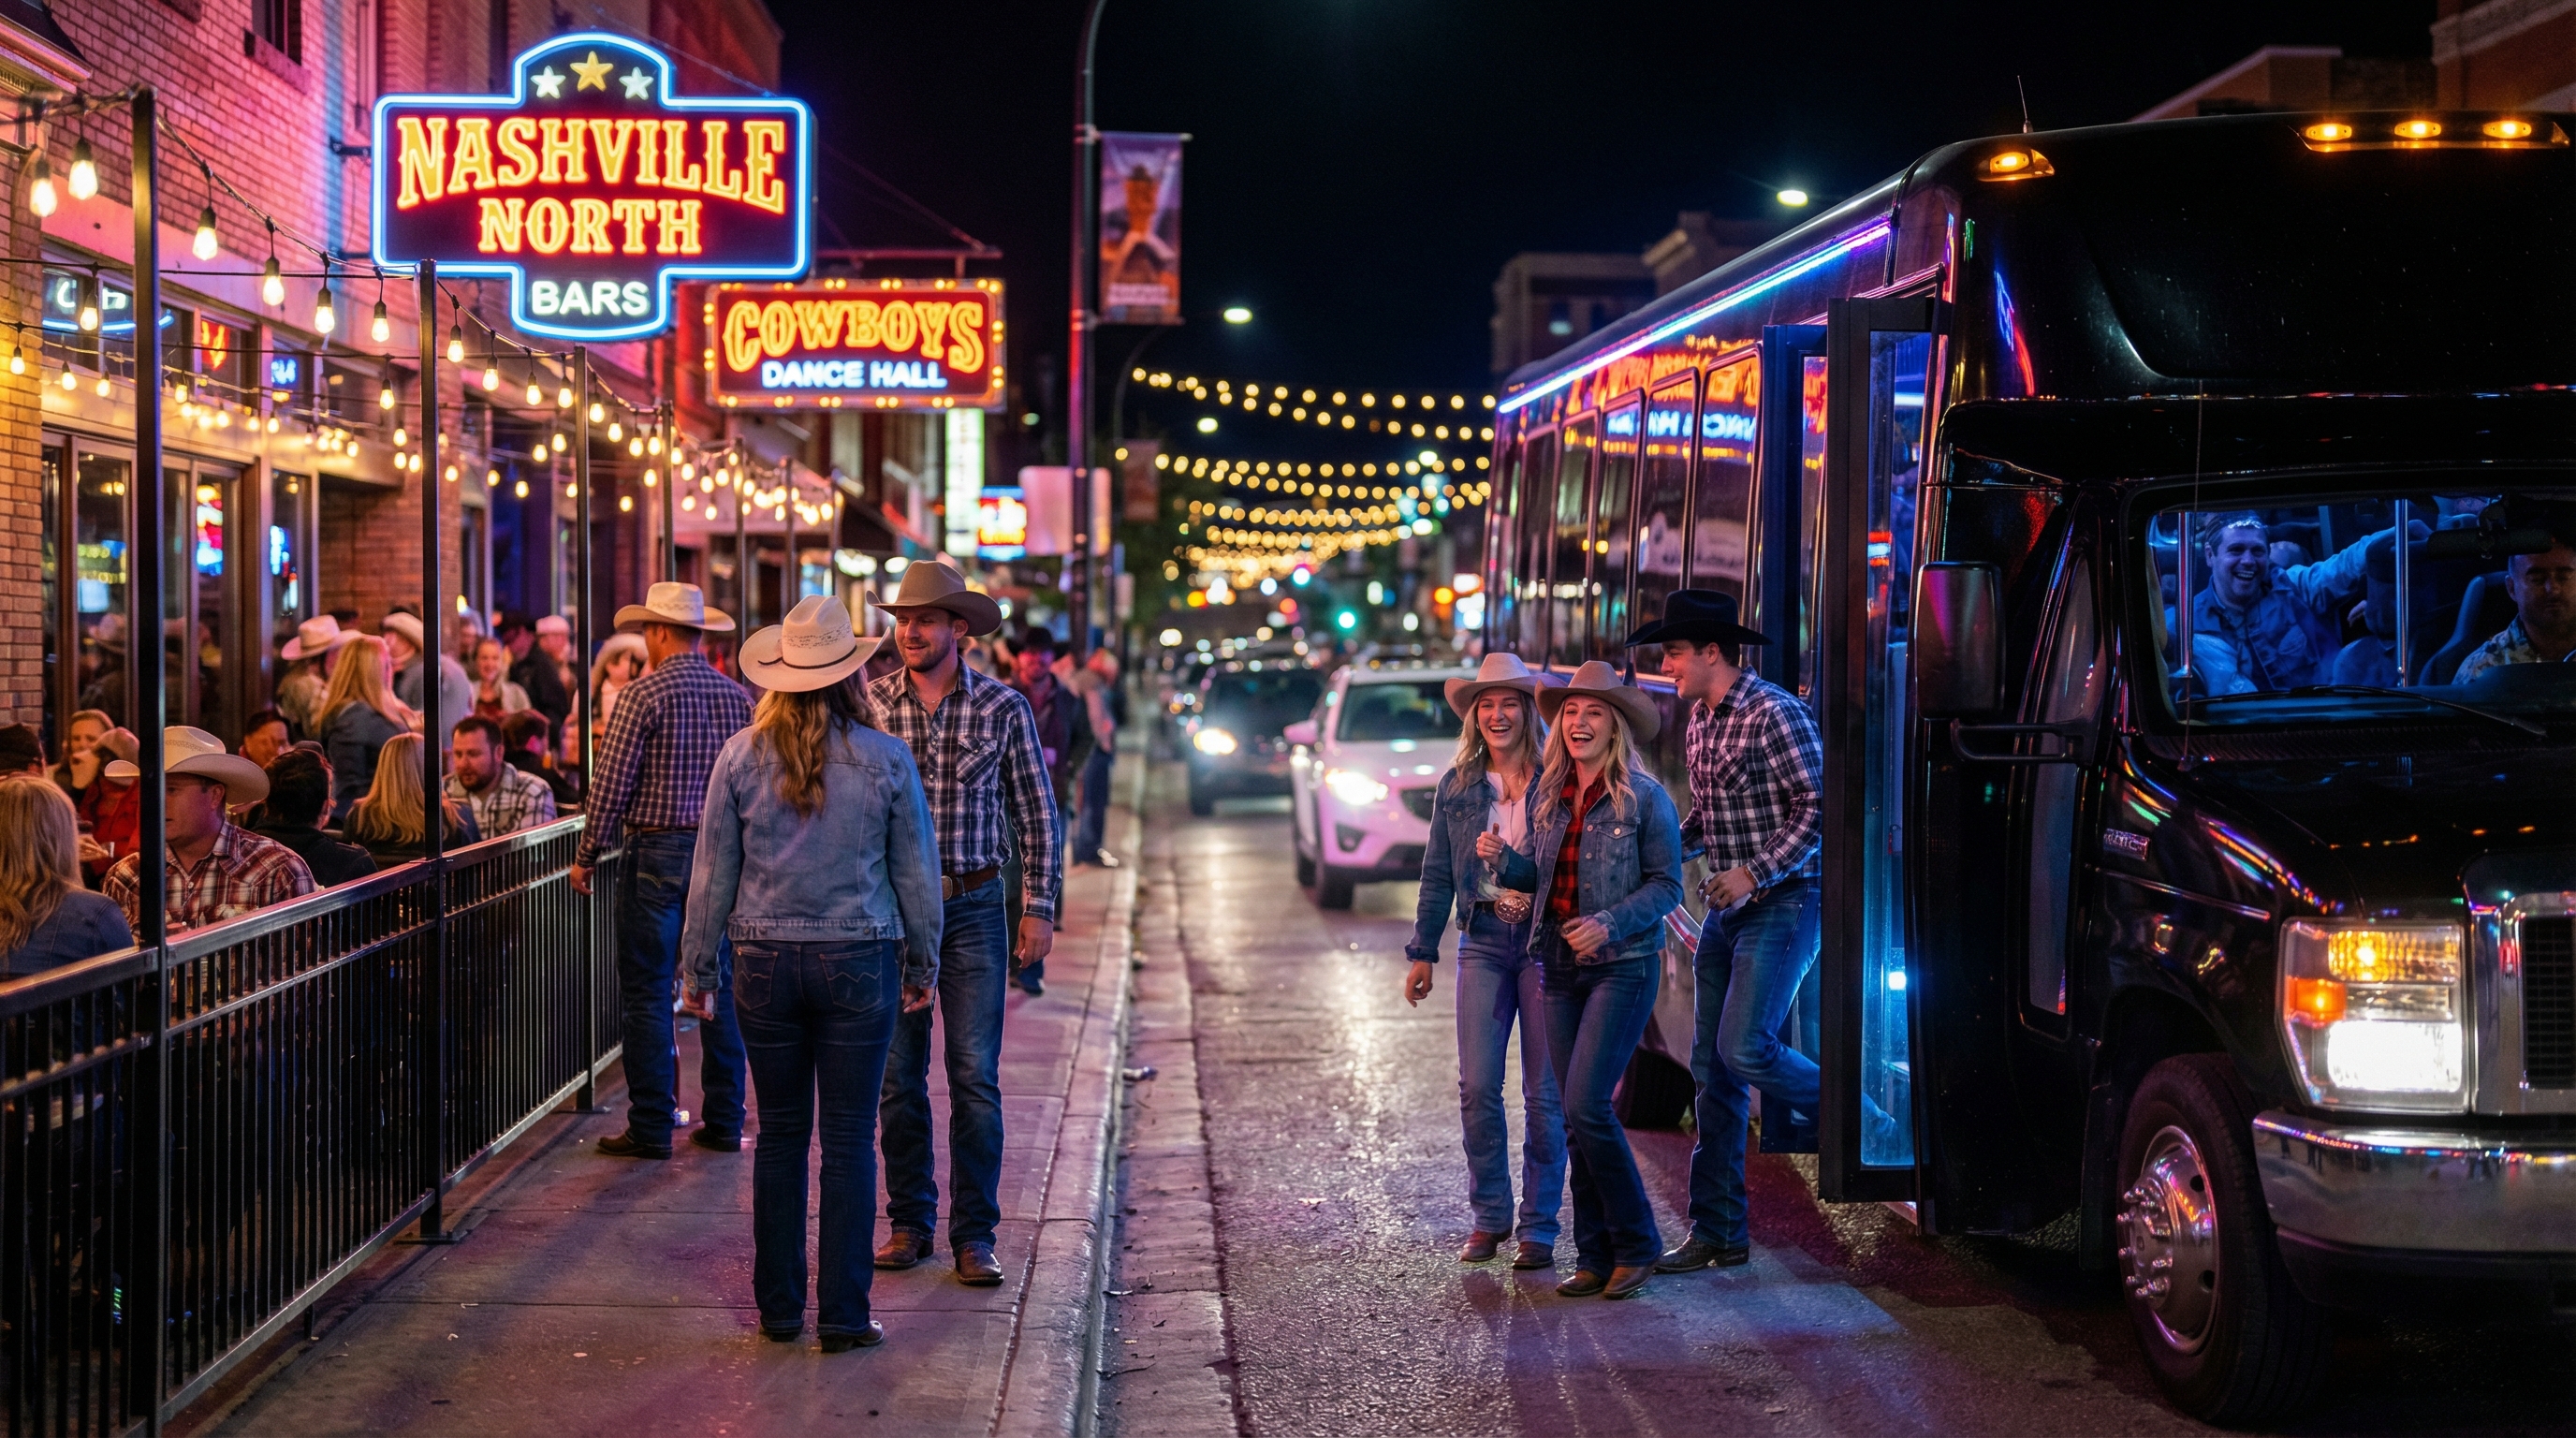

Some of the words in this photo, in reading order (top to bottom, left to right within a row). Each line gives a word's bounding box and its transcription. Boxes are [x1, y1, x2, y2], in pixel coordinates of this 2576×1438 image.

[397, 117, 784, 214] NASHVILLE
[478, 198, 702, 254] NORTH
[532, 281, 649, 315] BARS
[723, 300, 984, 374] COWBOYS
[761, 360, 865, 389] DANCE
[870, 361, 948, 389] HALL
